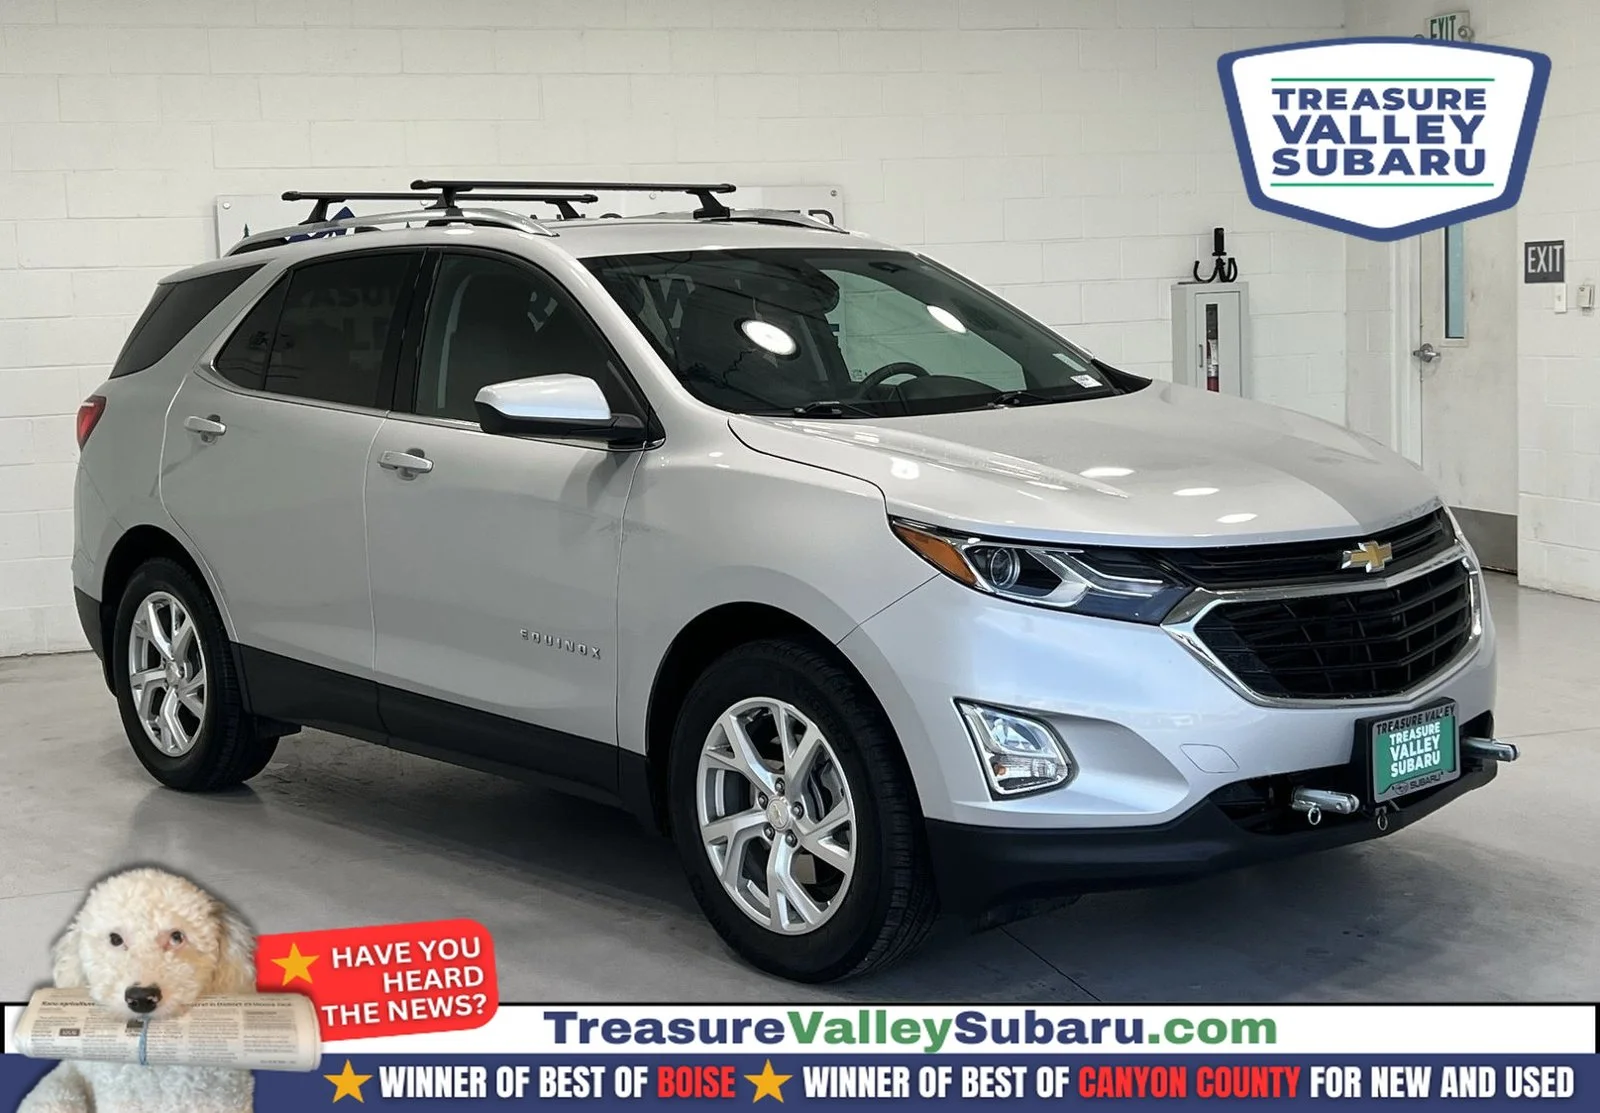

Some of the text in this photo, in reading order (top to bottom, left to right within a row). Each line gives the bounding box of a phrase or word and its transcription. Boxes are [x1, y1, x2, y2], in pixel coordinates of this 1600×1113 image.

[1528, 245, 1563, 273] EXIT
[520, 628, 601, 660] EQUINOX
[1376, 713, 1423, 735] TREASURE
[1389, 721, 1441, 746] TREASURE
[1389, 734, 1441, 761] VALLEY
[1390, 750, 1441, 777] SUBARU
[1409, 774, 1441, 789] SUBARU
